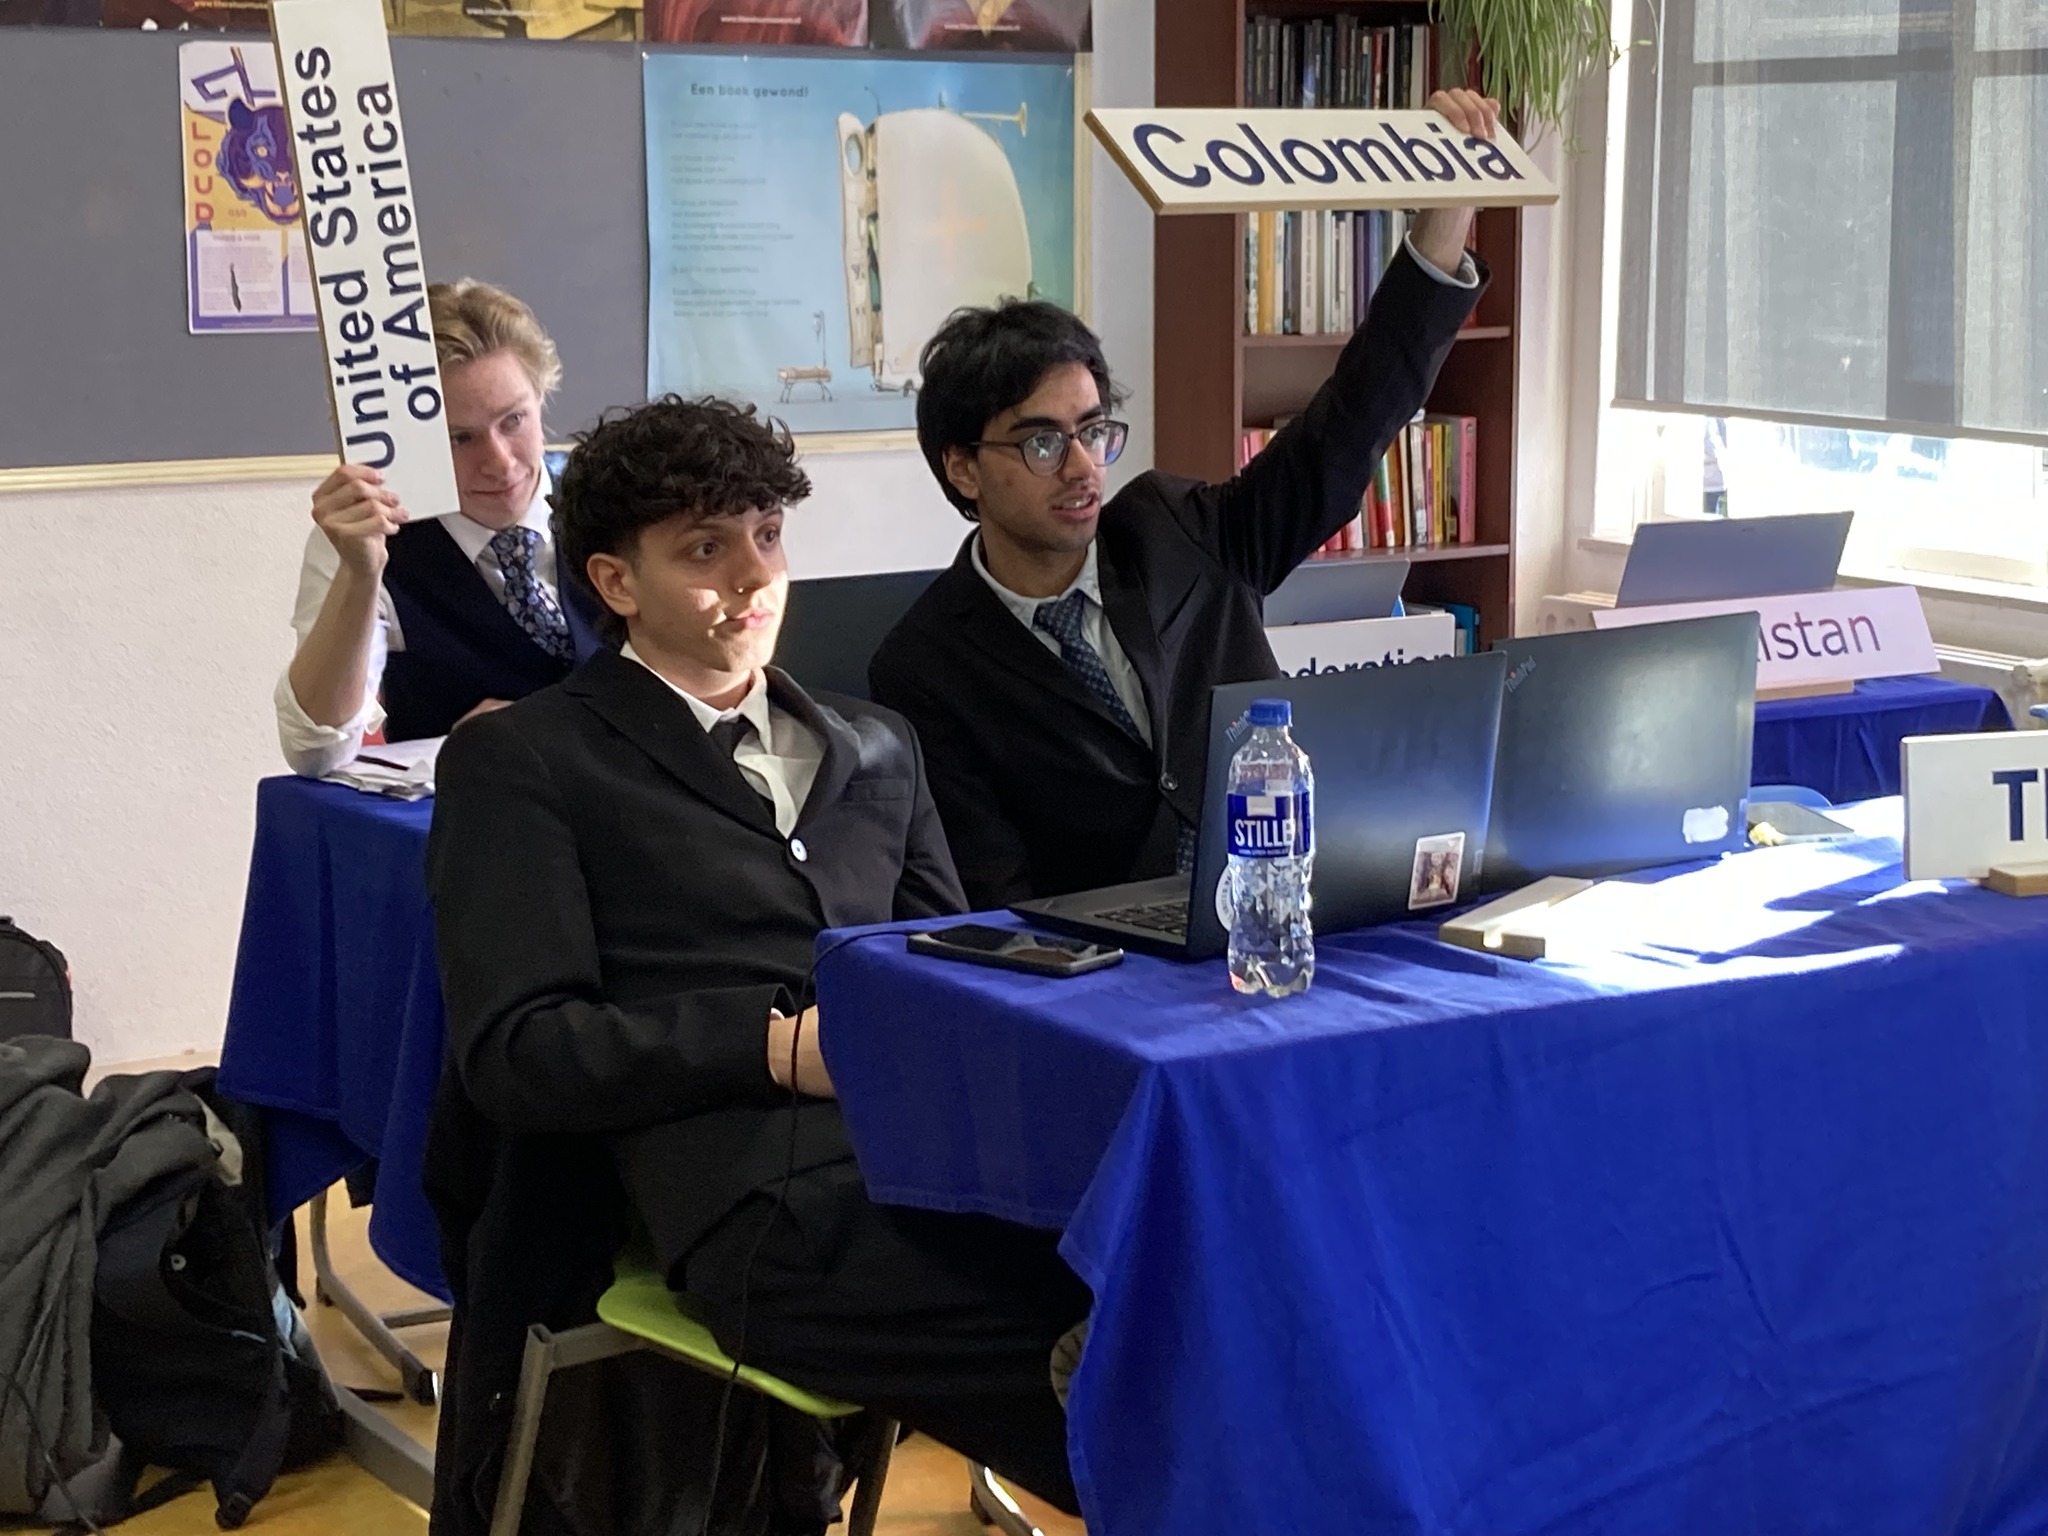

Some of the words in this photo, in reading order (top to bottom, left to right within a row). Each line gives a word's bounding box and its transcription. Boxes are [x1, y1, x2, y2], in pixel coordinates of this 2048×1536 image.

[691, 83, 714, 96] Een
[295, 47, 358, 248] States
[1132, 122, 1527, 188] Colombia
[356, 81, 431, 343] America
[319, 269, 395, 469] United
[389, 363, 441, 421] of
[1757, 611, 1881, 662] istan
[1225, 709, 1251, 743] ThinkP
[1992, 767, 2048, 842] T
